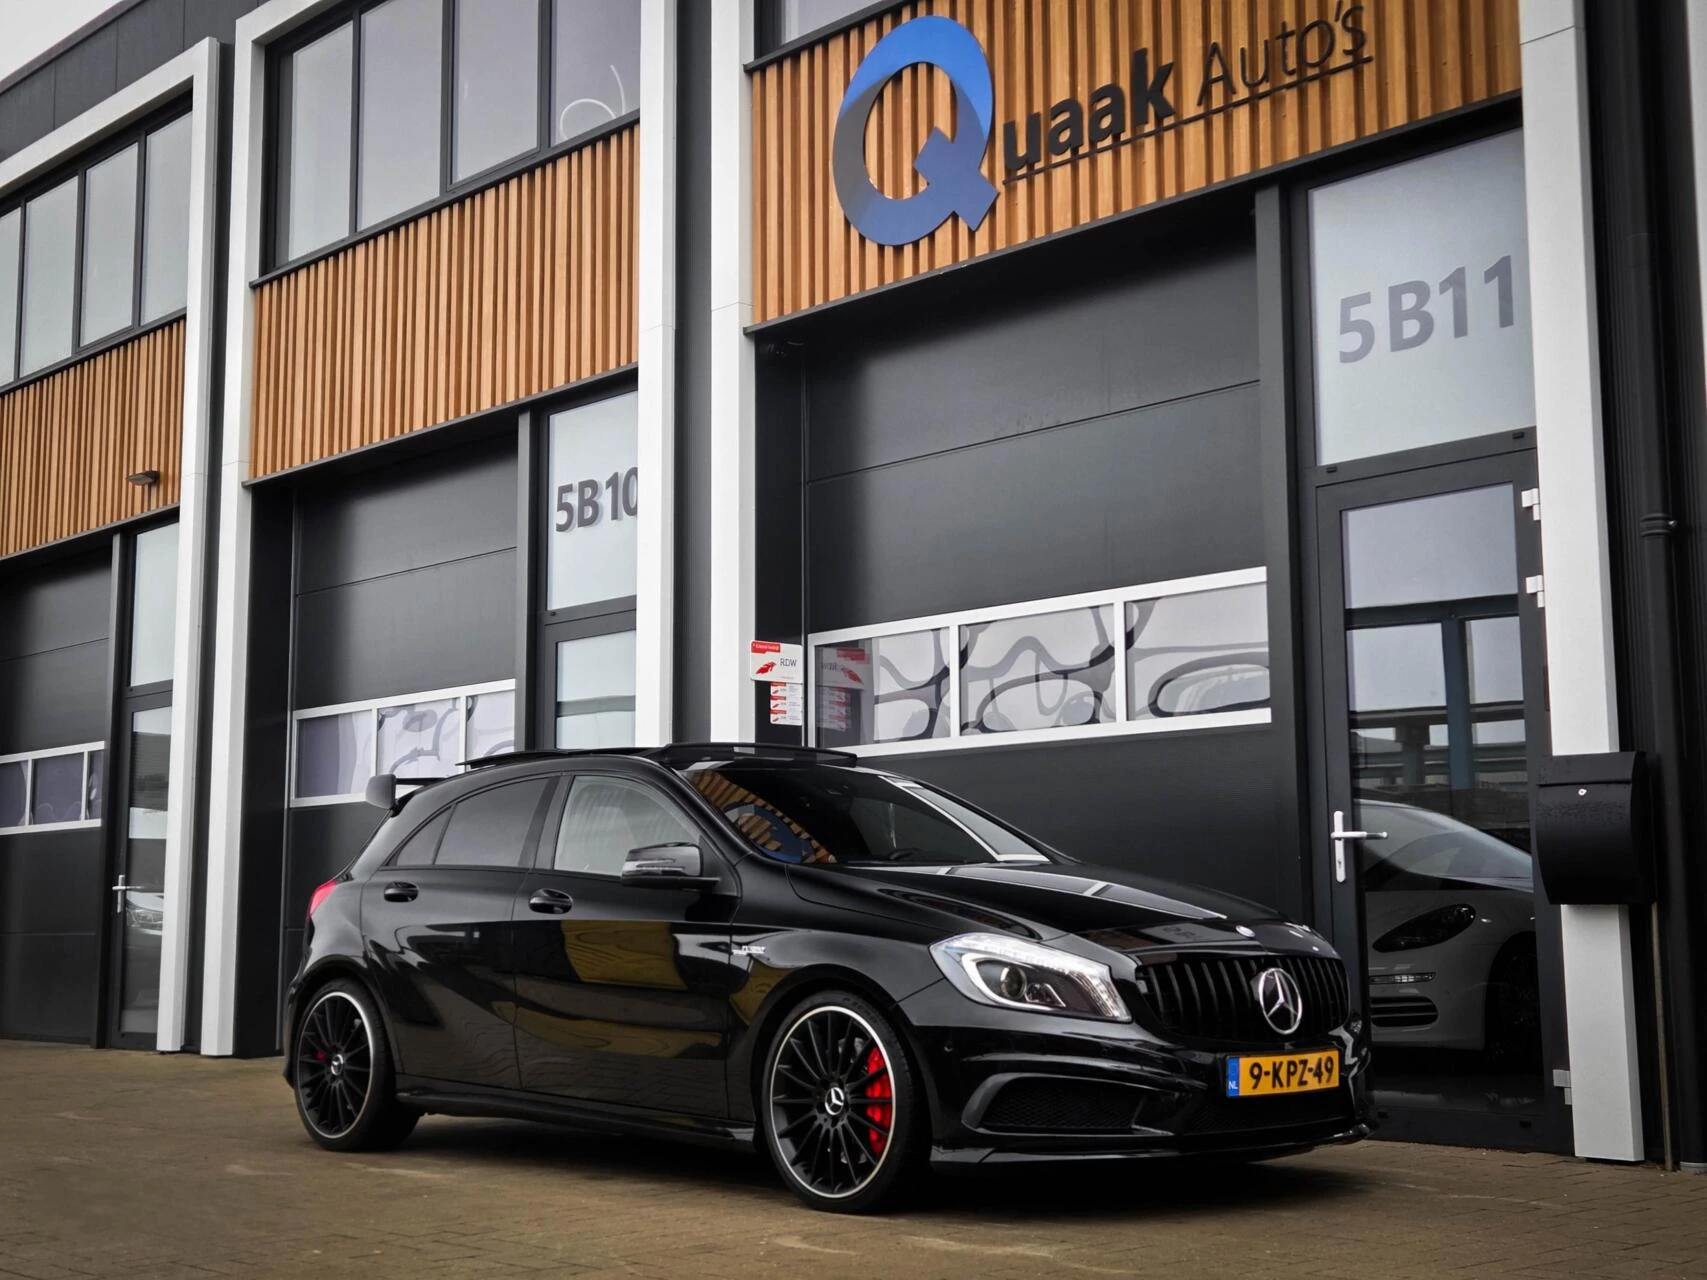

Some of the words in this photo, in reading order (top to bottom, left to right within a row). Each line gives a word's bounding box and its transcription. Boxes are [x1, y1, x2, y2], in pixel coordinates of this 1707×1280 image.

[833, 15, 1175, 246] Quaak
[1197, 2, 1368, 106] Auto's
[1339, 255, 1514, 363] 5B11
[556, 466, 637, 532] 5B10
[780, 658, 797, 667] RDW
[1228, 1081, 1238, 1089] NL
[1249, 1056, 1334, 1090] 9-KPZ-49
